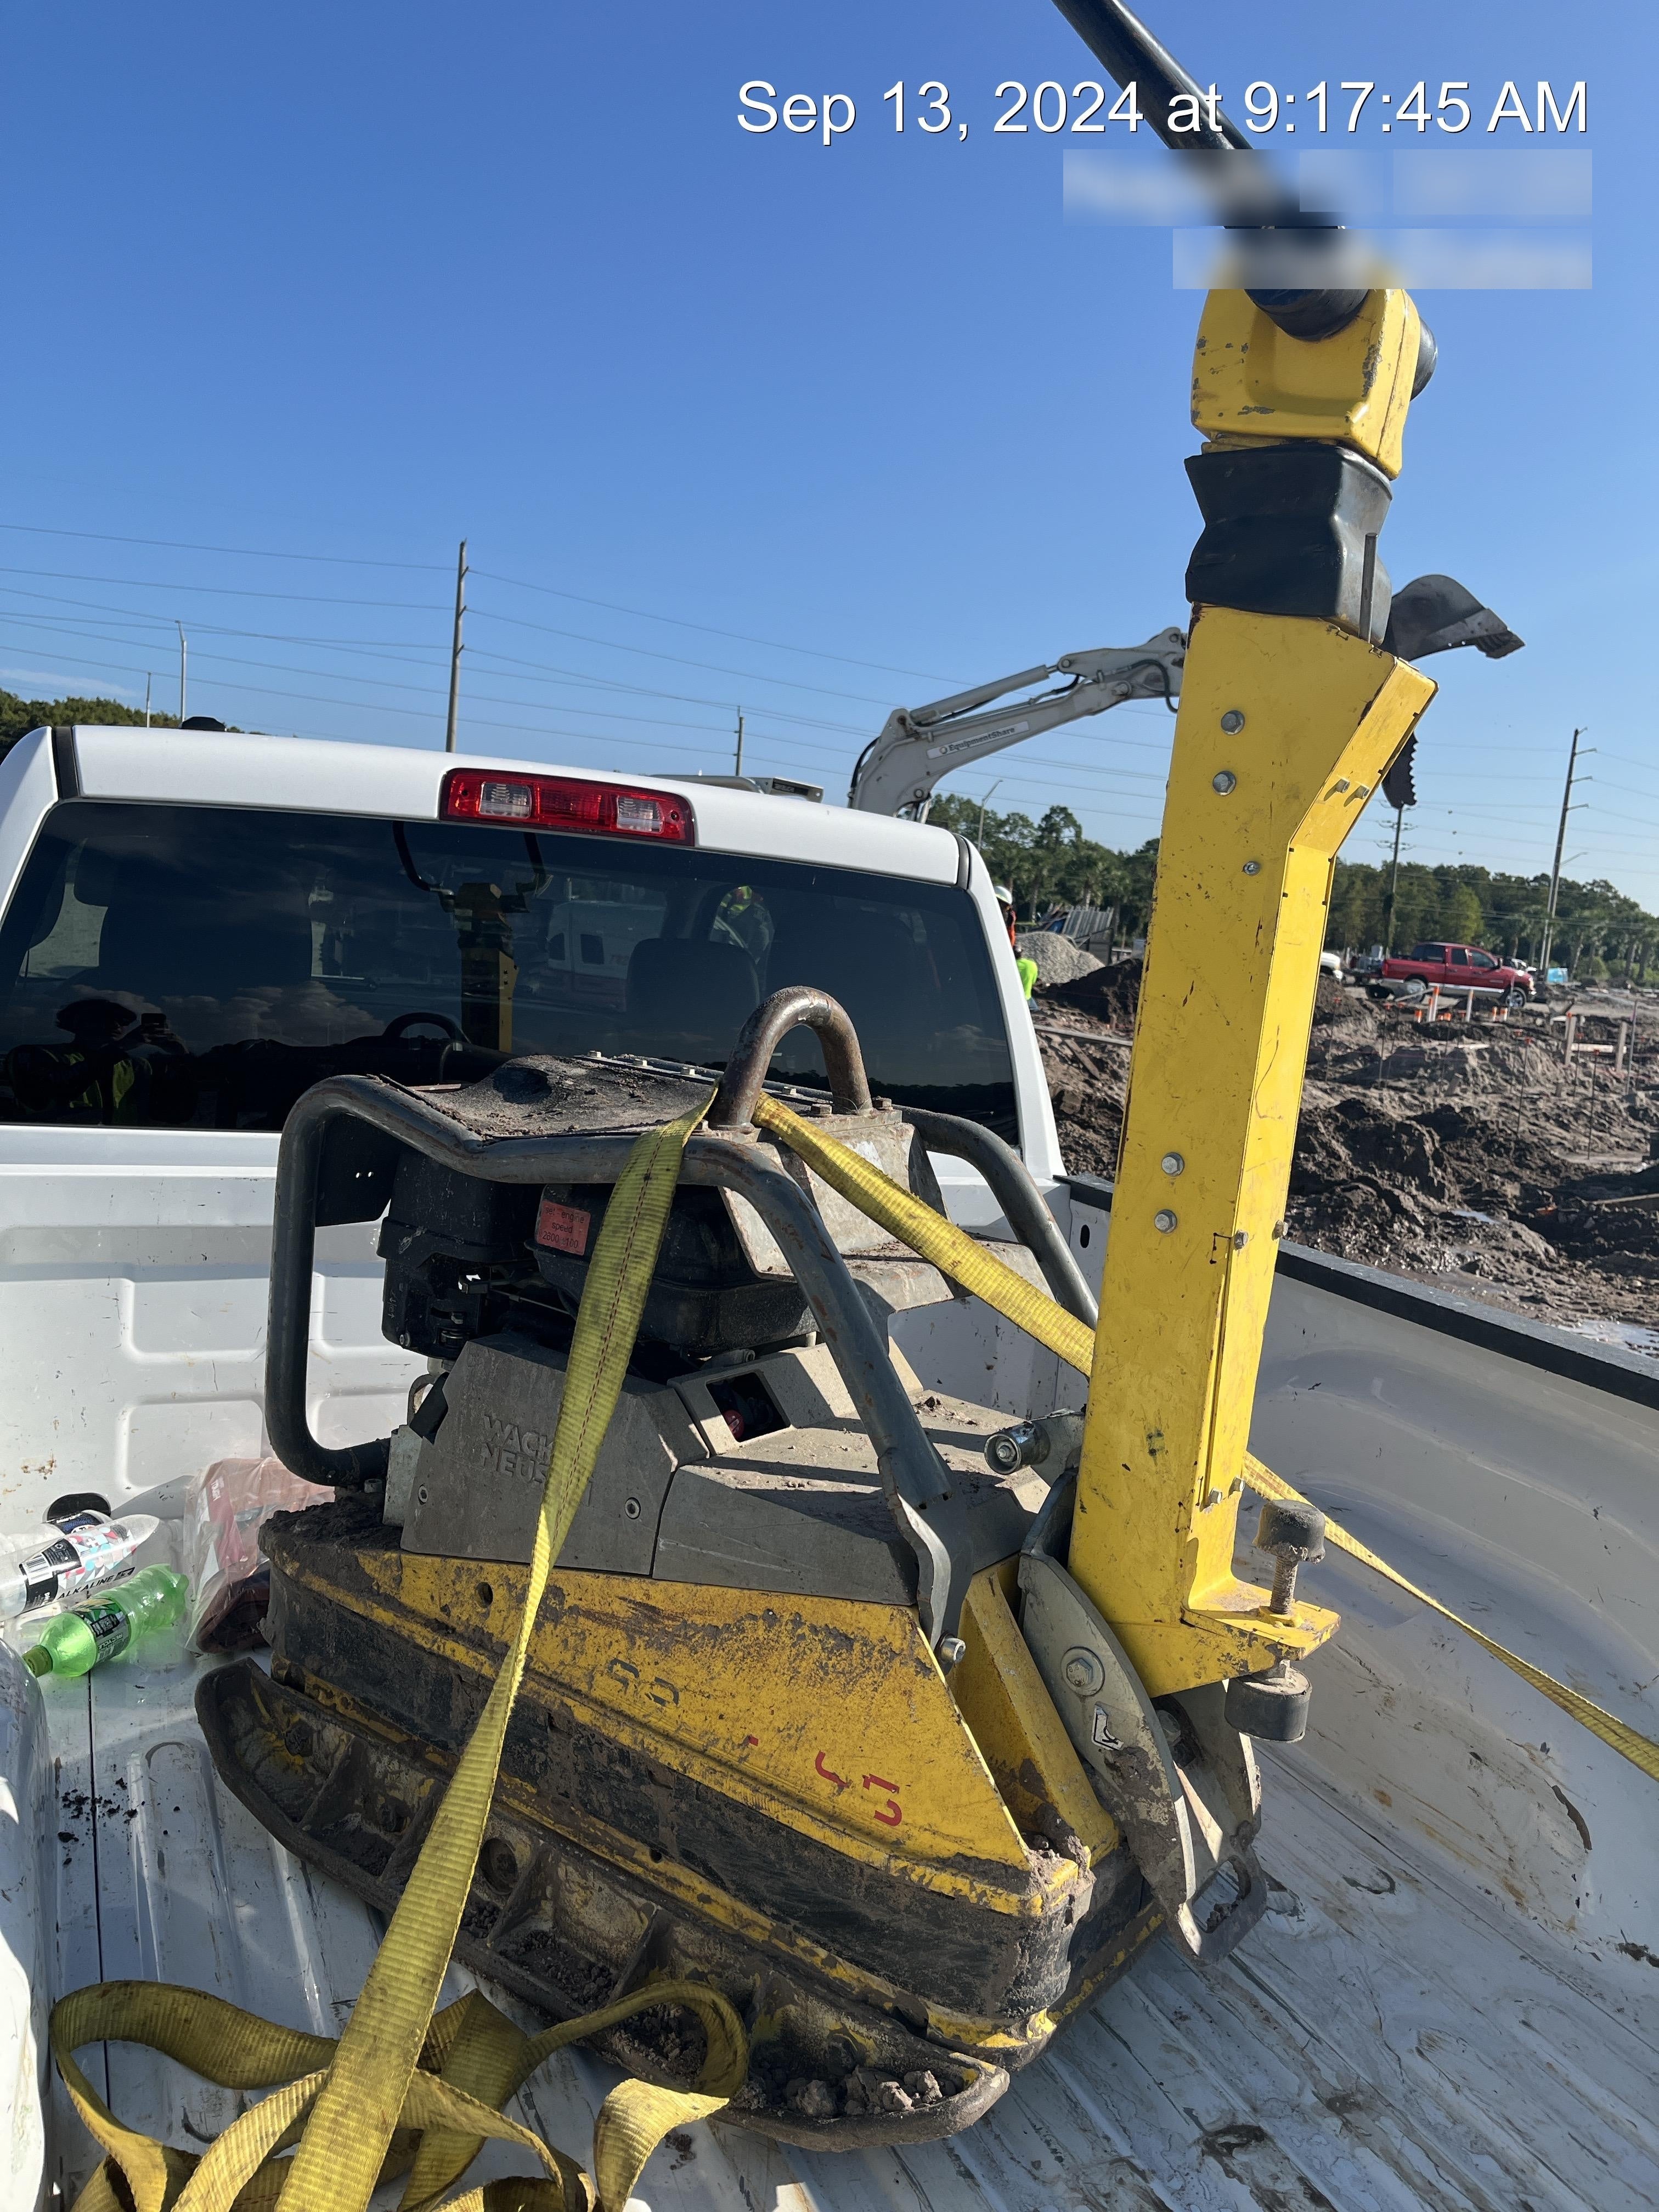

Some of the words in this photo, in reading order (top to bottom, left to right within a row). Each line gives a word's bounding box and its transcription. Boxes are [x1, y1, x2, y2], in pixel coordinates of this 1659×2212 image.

[948, 727, 1015, 751] EquipmentShare
[551, 1222, 573, 1233] speed
[561, 1211, 584, 1223] engine
[482, 1413, 553, 1467] WACK
[58, 1575, 114, 1600] ALKALINE
[98, 1632, 123, 1650] RECYCLE
